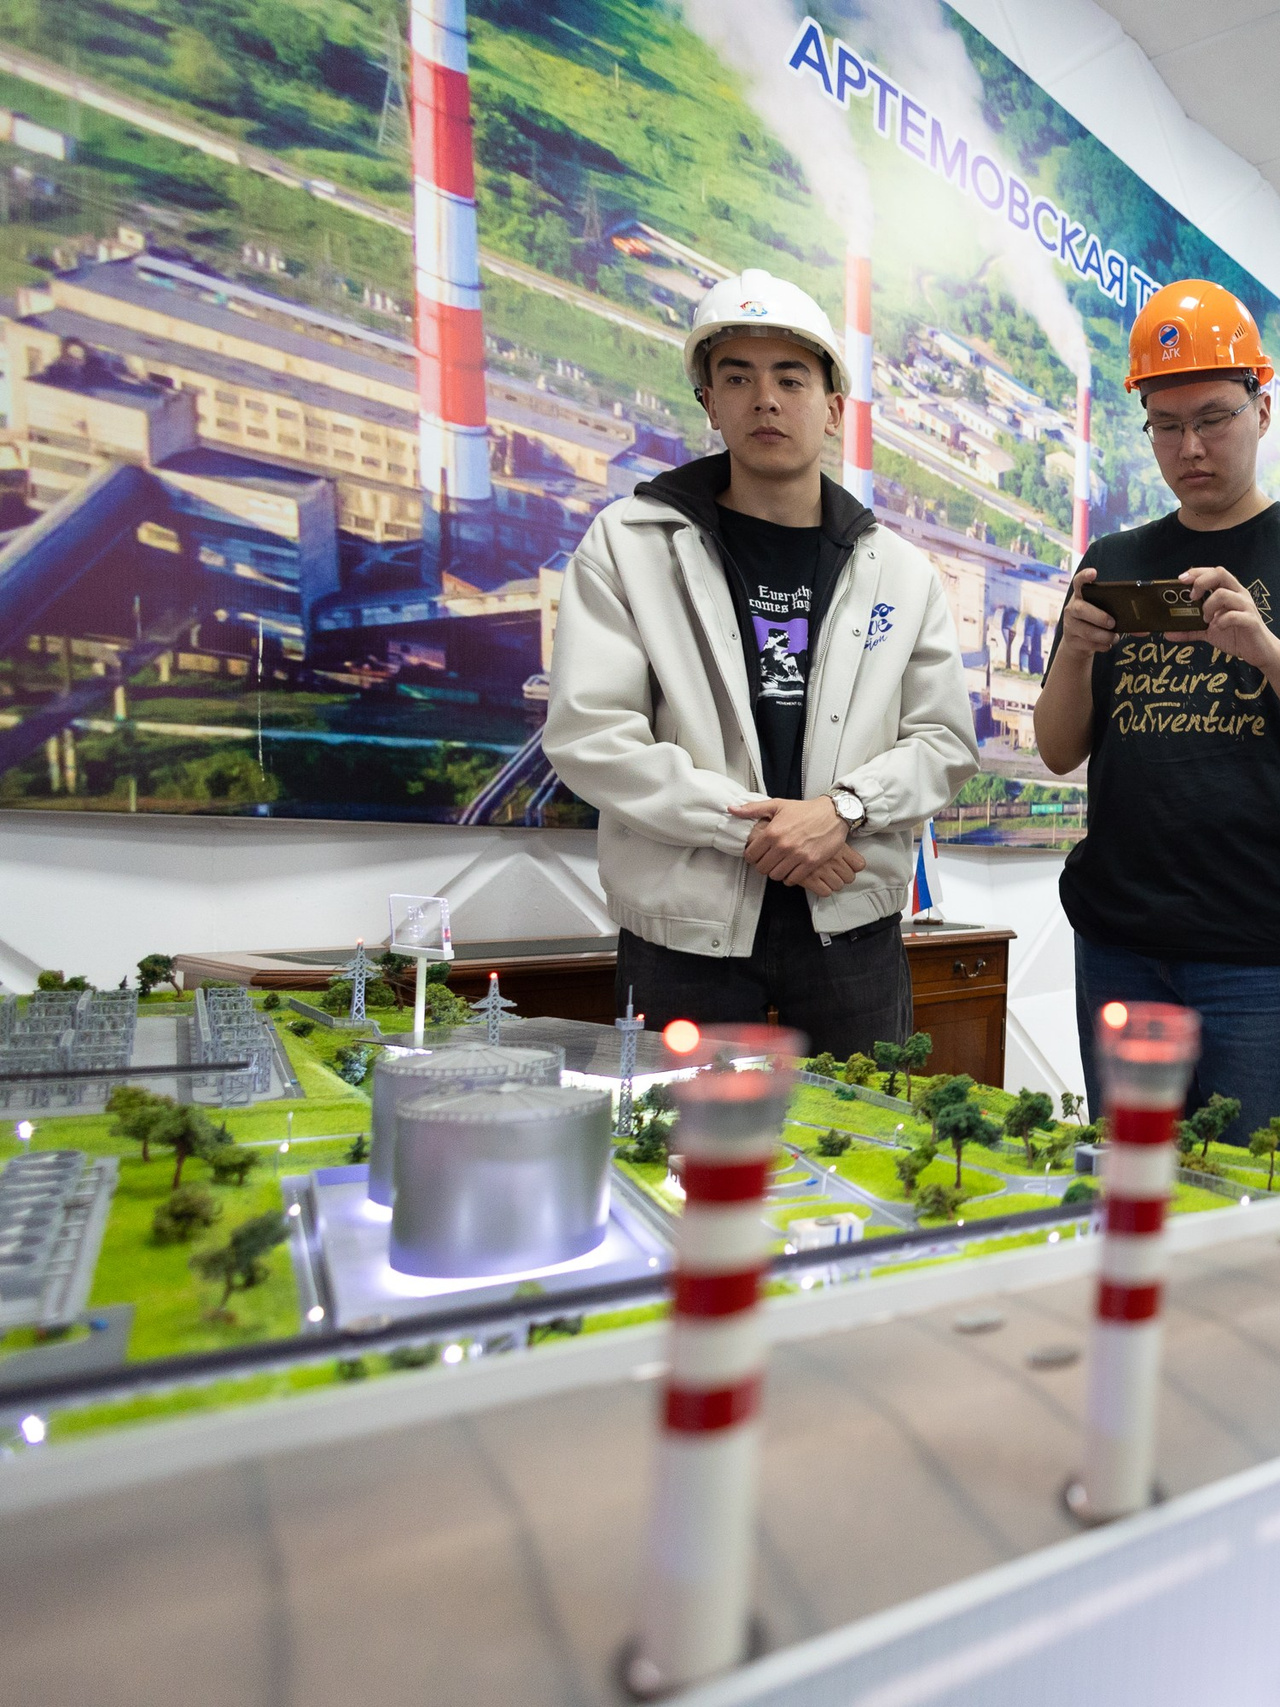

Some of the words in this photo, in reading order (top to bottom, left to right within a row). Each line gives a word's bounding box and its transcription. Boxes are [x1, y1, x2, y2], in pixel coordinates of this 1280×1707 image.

[788, 23, 1128, 301] АРТЕМОВСКАЯ
[1161, 347, 1181, 362] ДГК
[1115, 643, 1195, 666] save
[1114, 664, 1228, 695] nature
